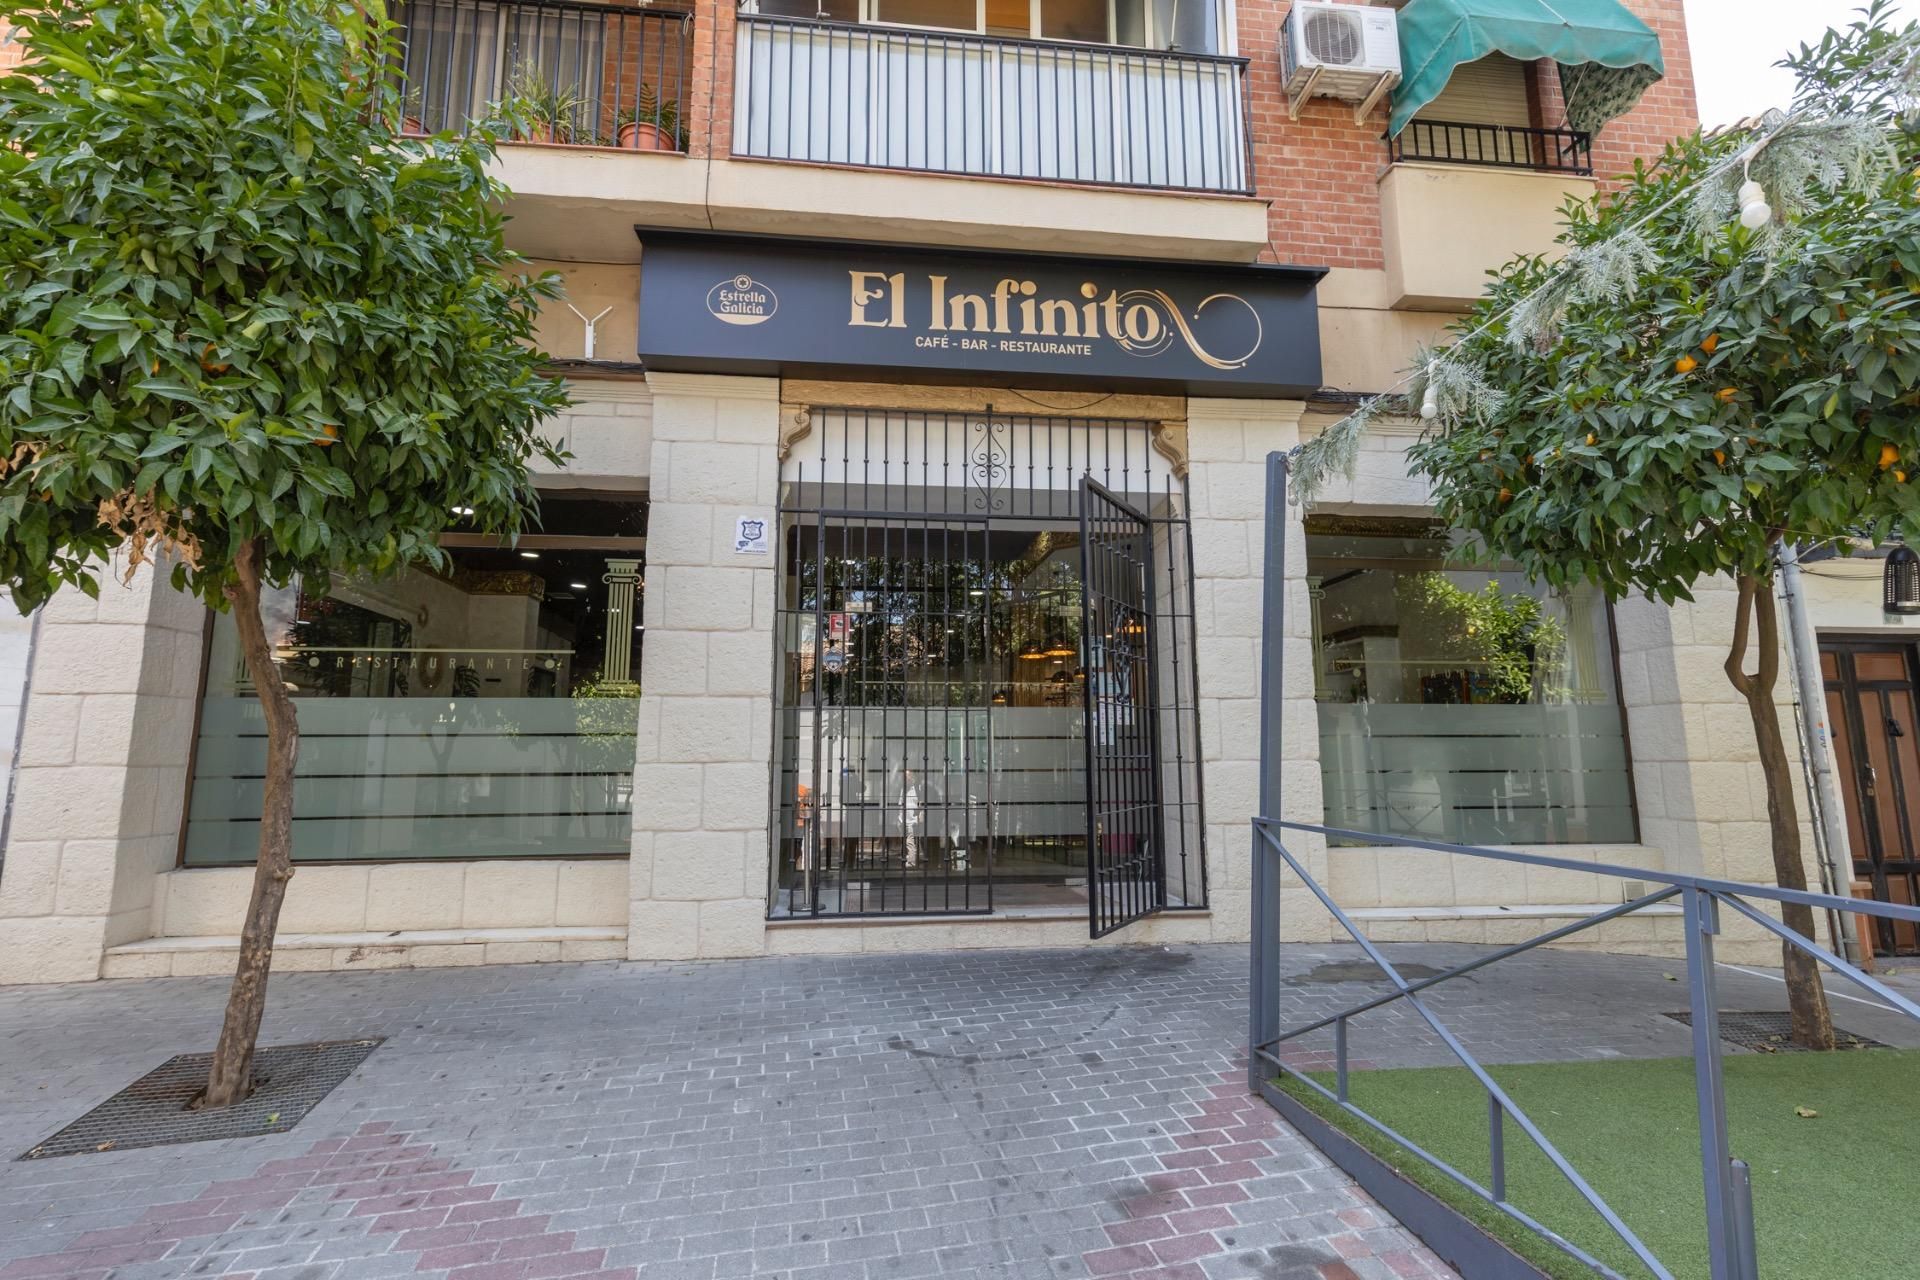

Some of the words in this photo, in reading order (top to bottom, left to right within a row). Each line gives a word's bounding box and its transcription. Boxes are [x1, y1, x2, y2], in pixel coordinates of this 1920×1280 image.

[719, 289, 766, 303] Estrella
[720, 301, 763, 315] Galicia
[848, 270, 907, 328] El
[928, 275, 1160, 342] Infinito
[915, 334, 949, 349] CAFÉ
[961, 338, 988, 350] BAR
[1000, 340, 1092, 356] RESTAURANTE
[336, 656, 529, 670] RESTAURANTE
